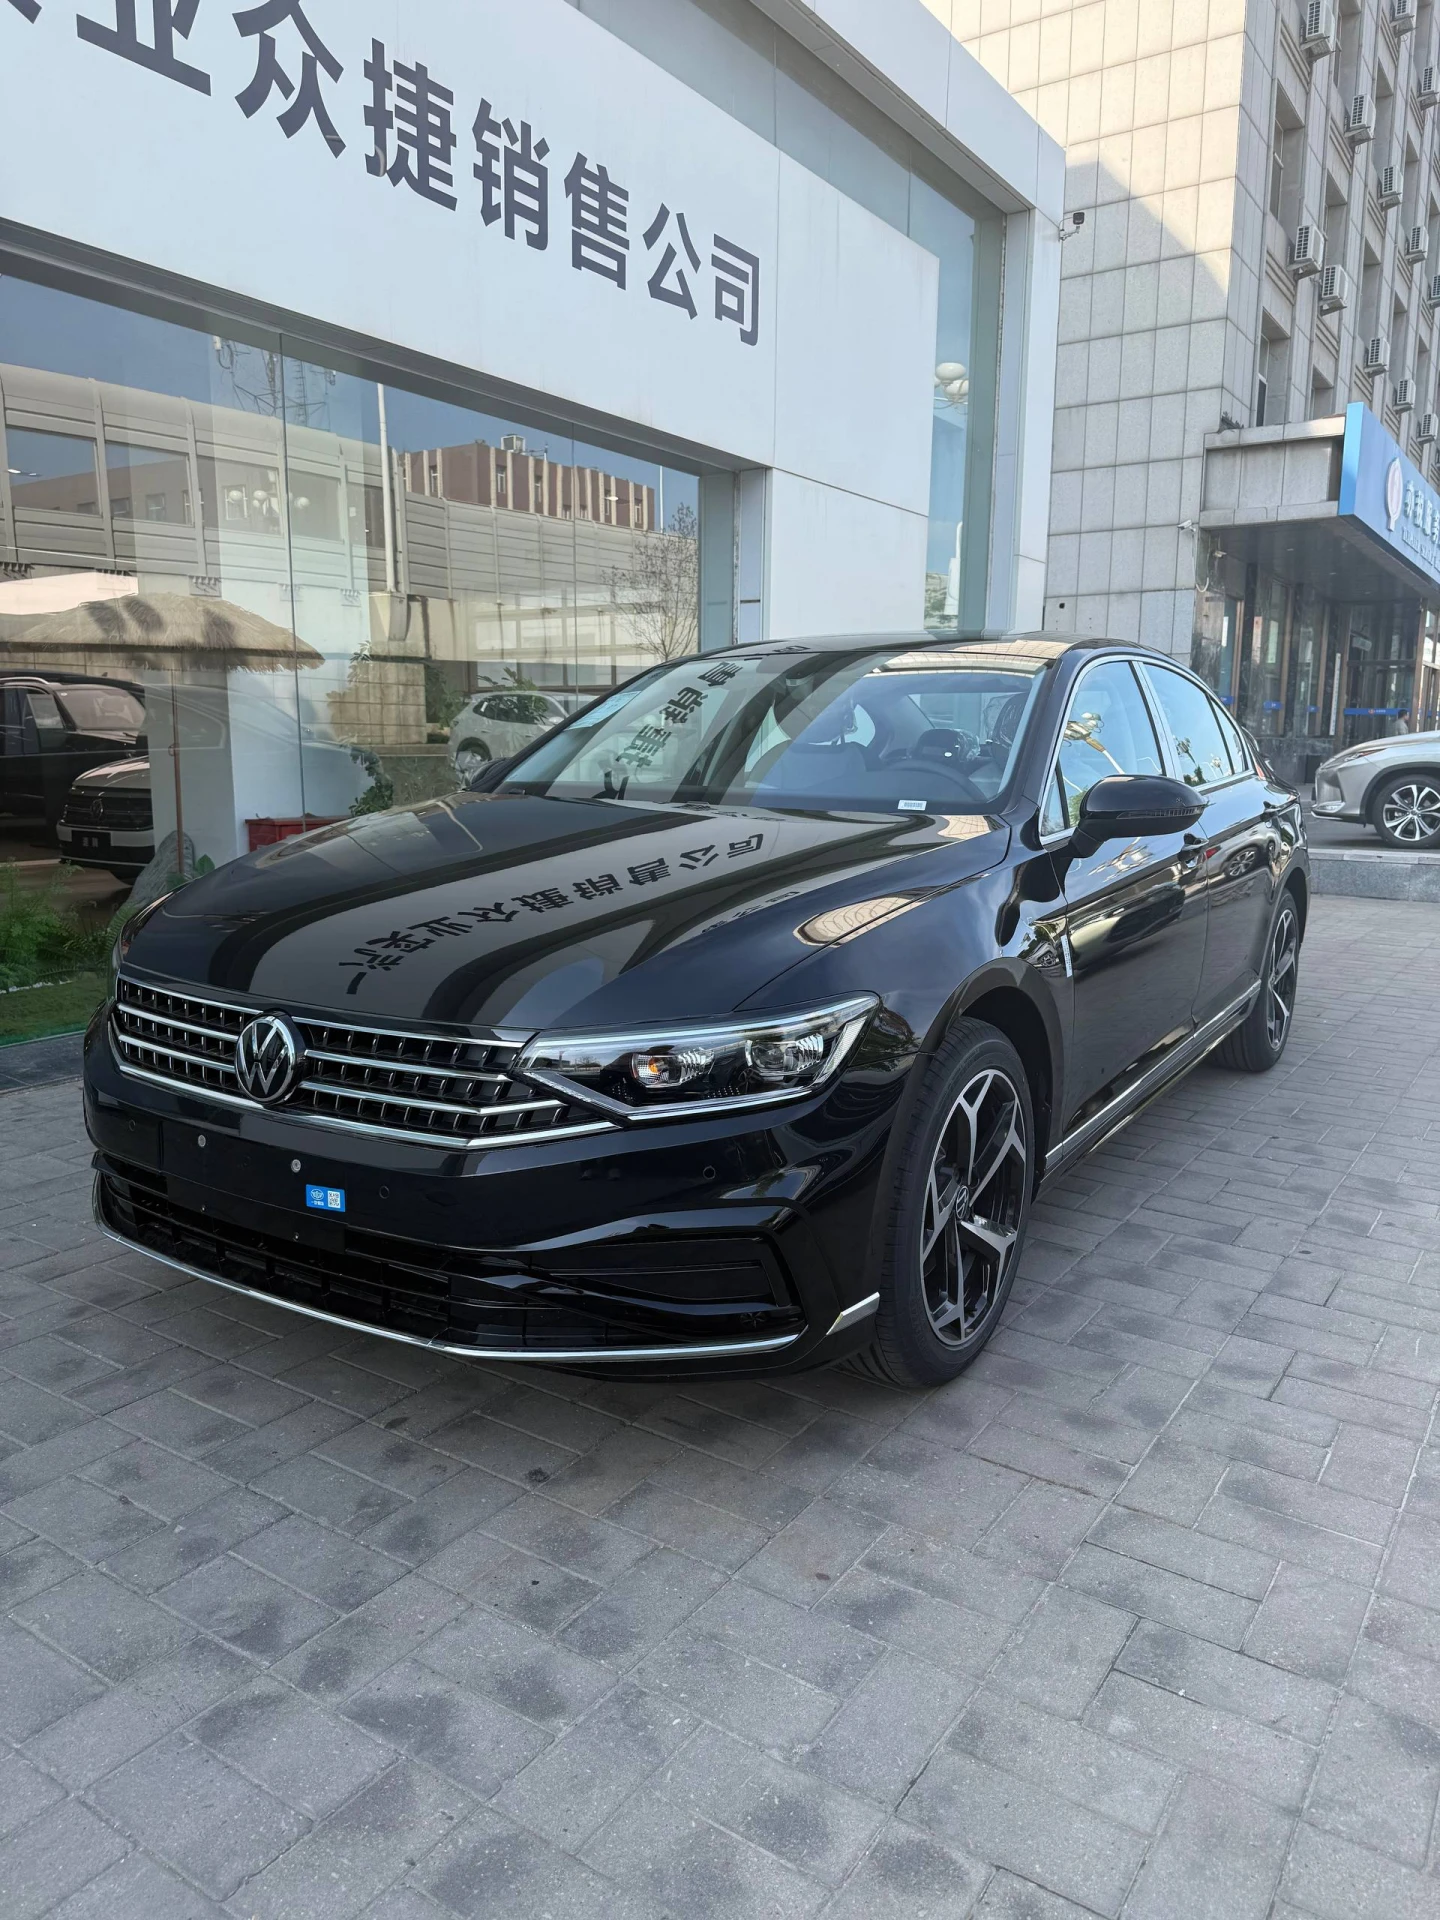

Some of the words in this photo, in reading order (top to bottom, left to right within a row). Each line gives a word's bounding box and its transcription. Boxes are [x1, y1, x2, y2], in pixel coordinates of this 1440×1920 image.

[8, 0, 760, 346] 业众捷销售公司
